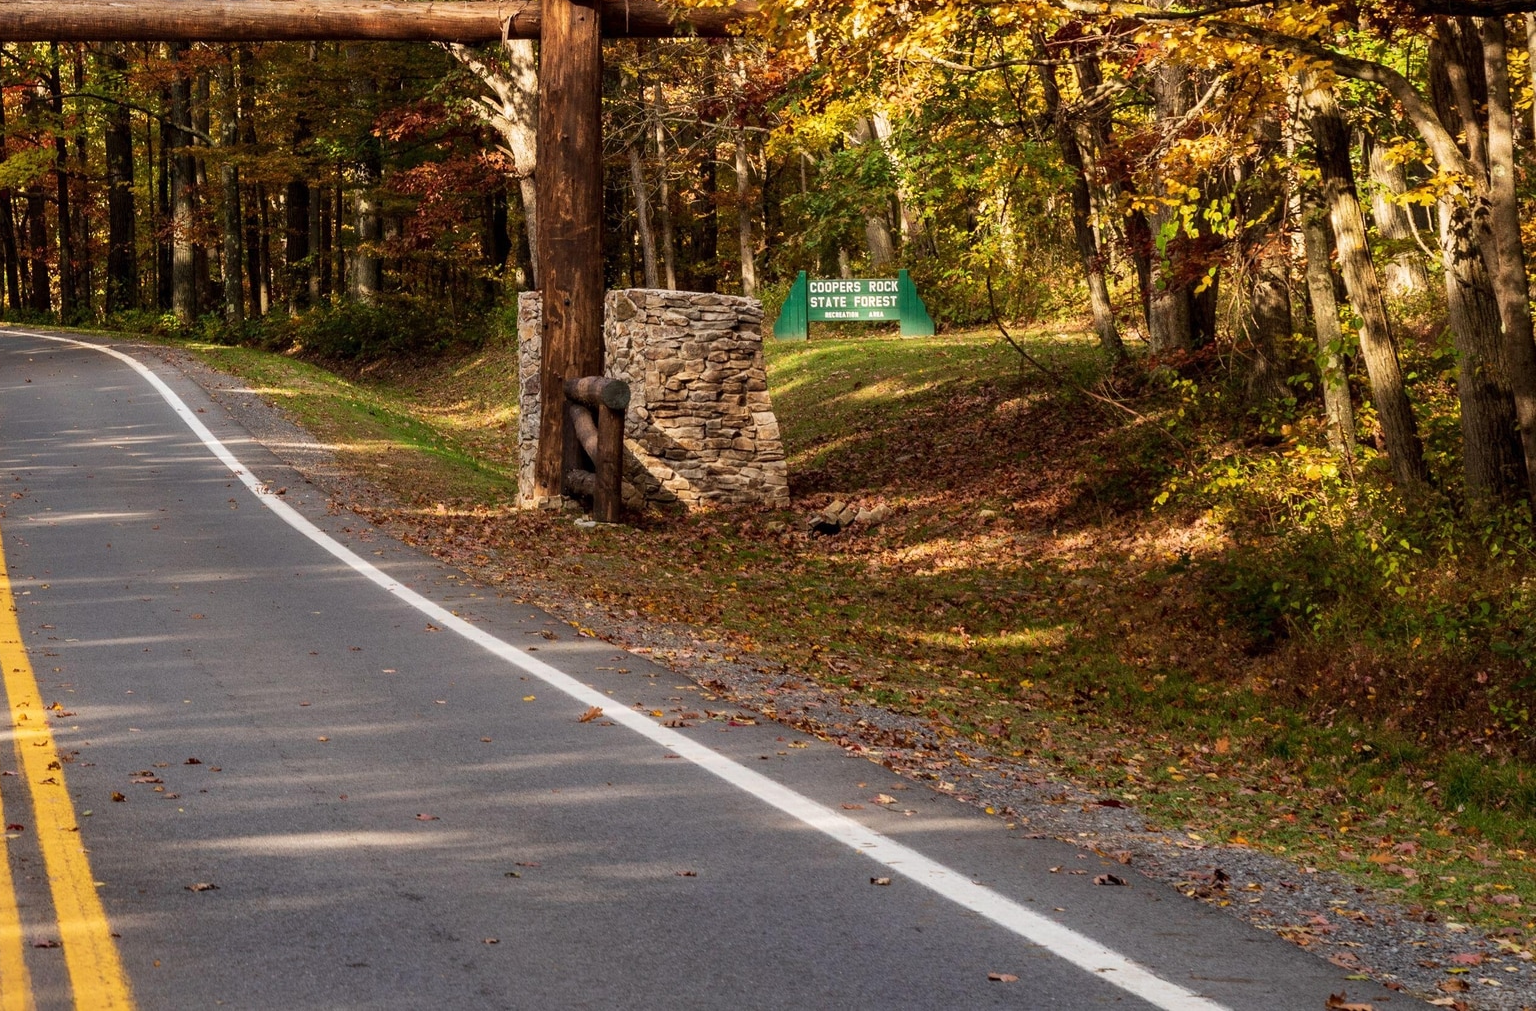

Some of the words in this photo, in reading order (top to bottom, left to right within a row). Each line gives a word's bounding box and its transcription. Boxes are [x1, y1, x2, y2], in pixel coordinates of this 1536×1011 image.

[809, 282, 861, 293] COOPERS
[869, 281, 898, 292] ROCK
[810, 296, 847, 307] STATE
[854, 296, 897, 307] FOREST
